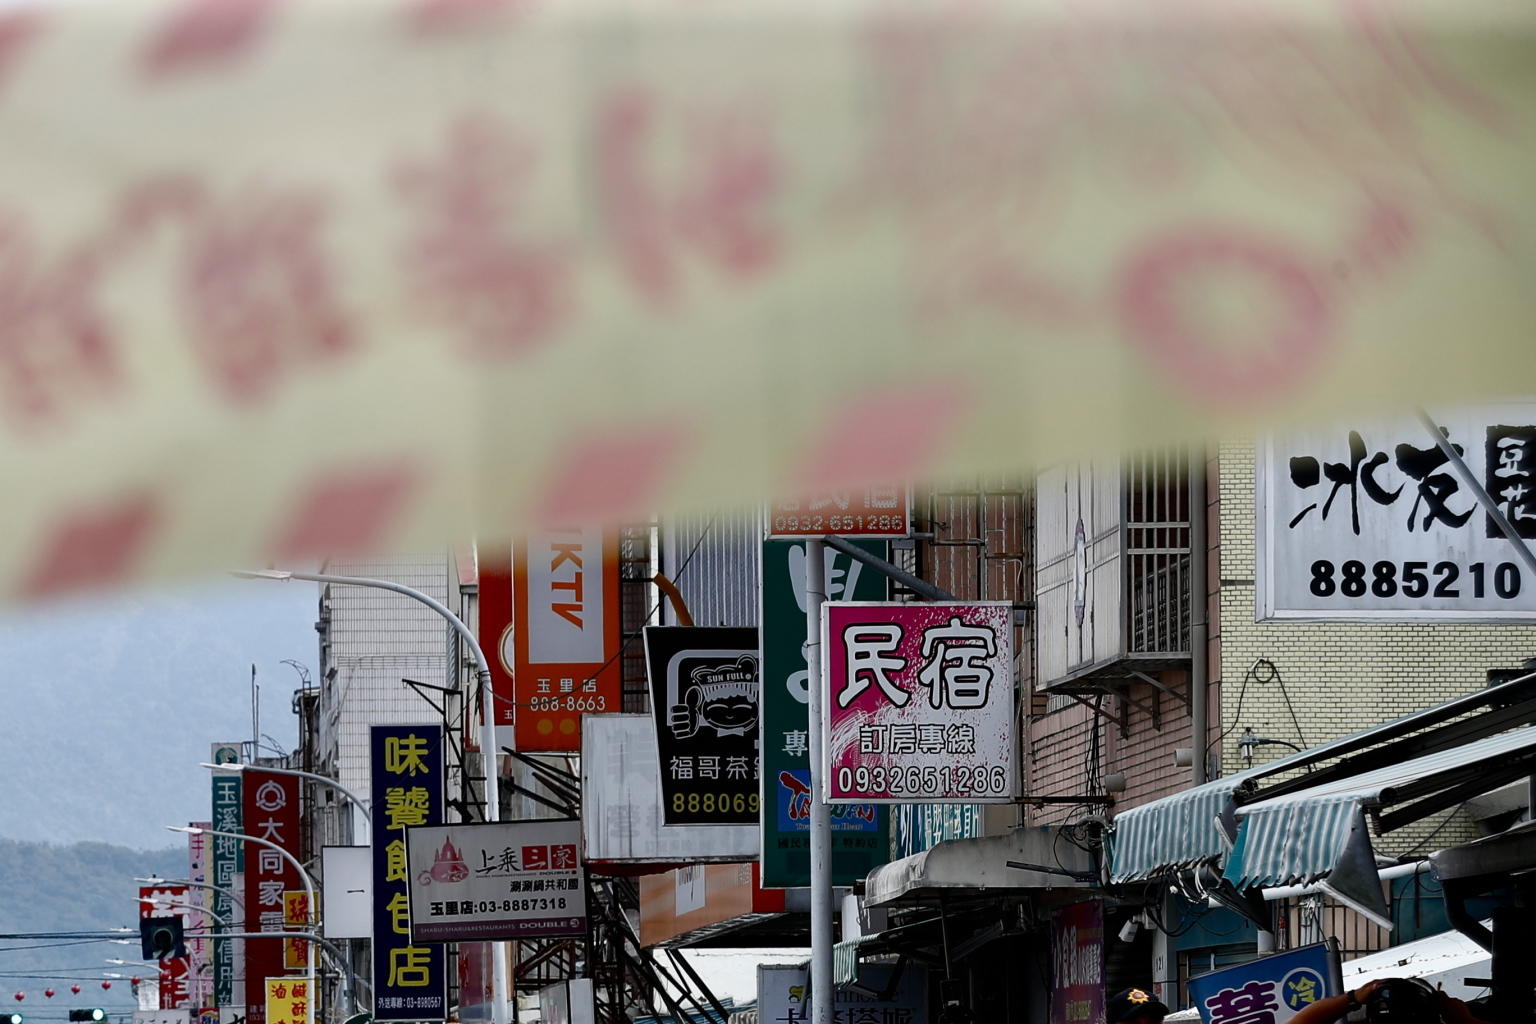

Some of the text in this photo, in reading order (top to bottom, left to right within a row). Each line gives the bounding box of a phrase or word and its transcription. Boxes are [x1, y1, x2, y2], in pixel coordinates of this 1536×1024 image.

[775, 515, 903, 531] 0932-651286
[1309, 560, 1522, 600] 8885210
[837, 616, 998, 709] 民宿
[537, 679, 597, 693] 玉里店
[530, 696, 606, 711] 888-8663
[859, 724, 976, 755] 訂房專線
[838, 766, 1006, 794] 0932651286
